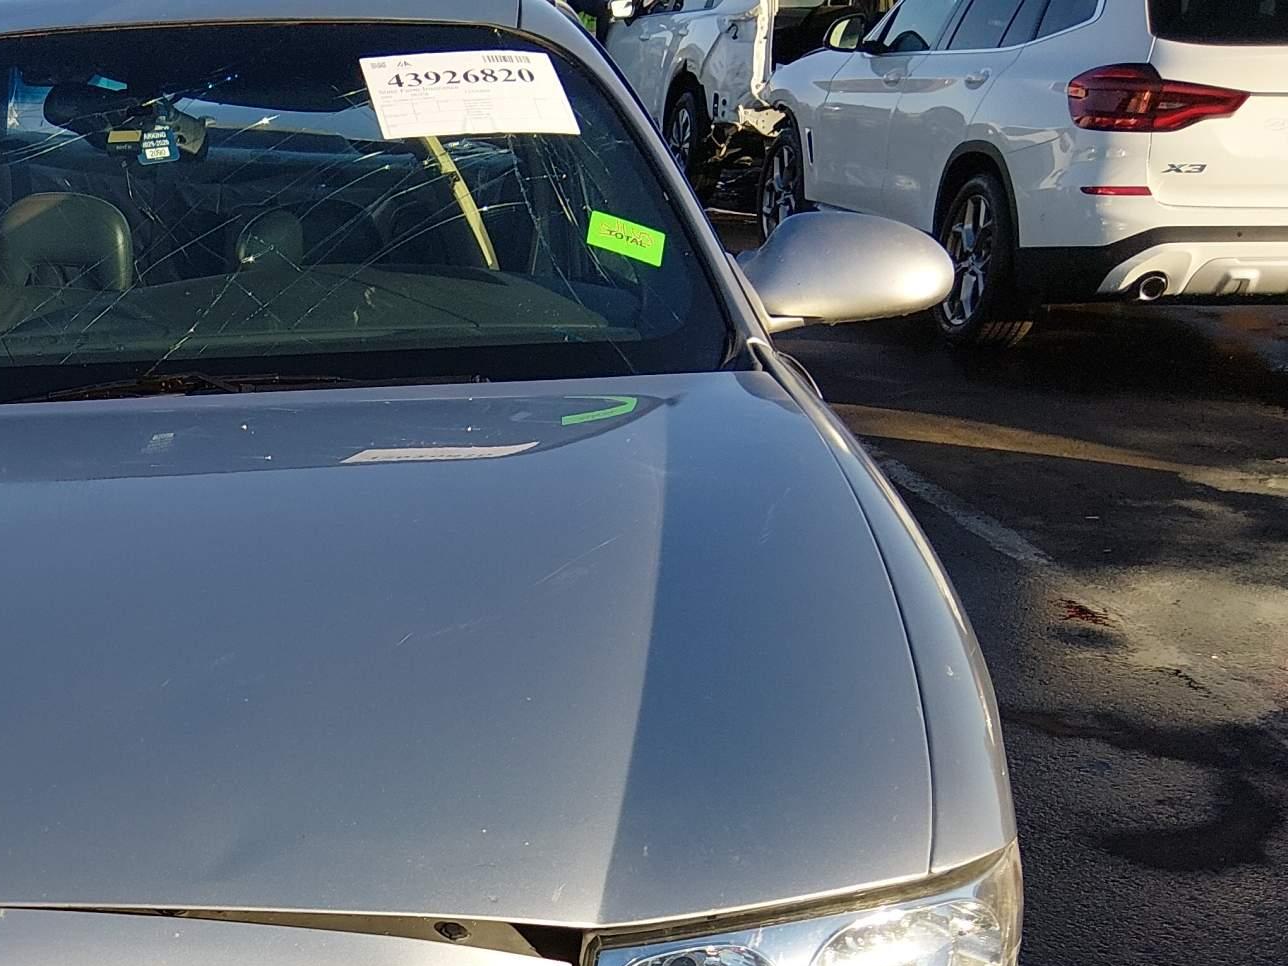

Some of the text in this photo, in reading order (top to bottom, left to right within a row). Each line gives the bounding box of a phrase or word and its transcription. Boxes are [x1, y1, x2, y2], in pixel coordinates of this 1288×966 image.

[387, 67, 535, 88] 43926820
[1161, 163, 1208, 174] X3
[606, 229, 647, 249] TOTAL
